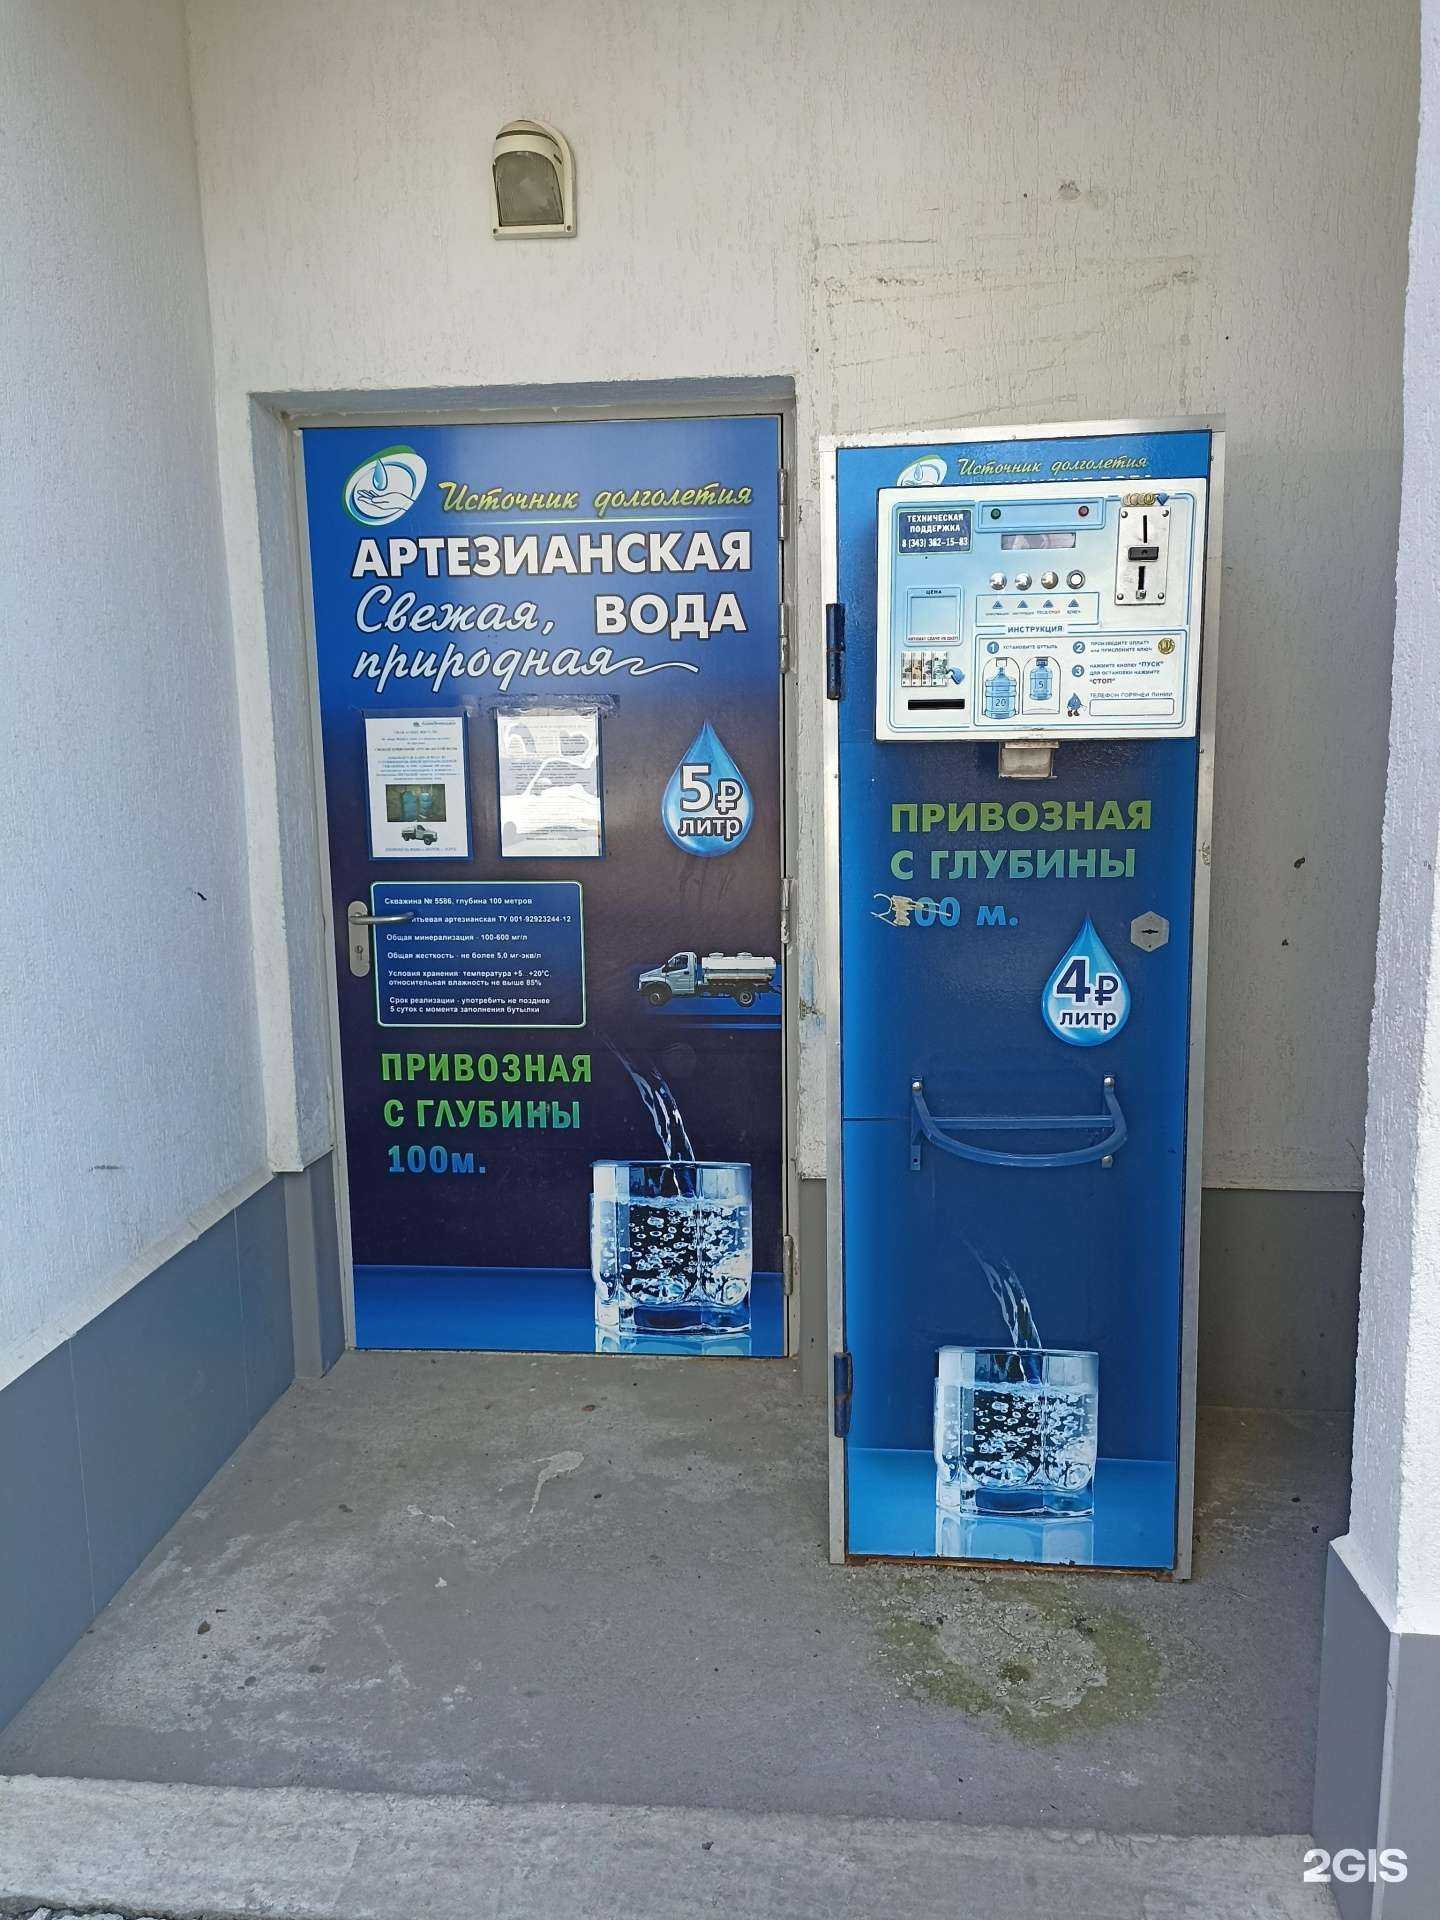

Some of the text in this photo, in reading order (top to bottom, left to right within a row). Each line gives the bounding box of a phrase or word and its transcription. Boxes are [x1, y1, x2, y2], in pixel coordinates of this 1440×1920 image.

[958, 456, 1149, 476] Источник долголетия
[438, 482, 752, 518] Источник долголетия
[907, 514, 964, 522] ТЕХНИЧЕСКАЯ
[910, 524, 960, 534] ПОДДЕРЖКА
[902, 539, 906, 548] 8
[908, 538, 926, 548] (343)
[352, 531, 751, 577] АРТЕЗИАНСКАЯ
[356, 584, 555, 635] Свежая,
[596, 593, 747, 640] ВОДА
[1008, 626, 1063, 634] ИНСТРУКЦИЯ
[352, 643, 699, 693] природная
[995, 698, 1006, 706] 20
[891, 800, 1152, 832] ПРИВОЗНАЯ
[678, 817, 743, 841] литр
[890, 849, 1136, 880] С ГЛУБИНЫ
[456, 898, 487, 906] глубина
[504, 898, 533, 906] метров
[976, 906, 1018, 926] м.
[386, 934, 412, 942] Общая
[387, 952, 413, 960] Общая
[497, 952, 508, 960] 5,0
[462, 970, 512, 978] температура
[390, 996, 408, 1004] Срок
[461, 996, 506, 1004] употребить
[396, 1006, 418, 1014] суток
[506, 1006, 540, 1014] бутылки
[1059, 1011, 1117, 1030] литр
[381, 1053, 592, 1082] ПРИВОЗНАЯ
[383, 1099, 580, 1128] С ГЛУБИНЫ
[388, 1145, 486, 1174] 100м.
